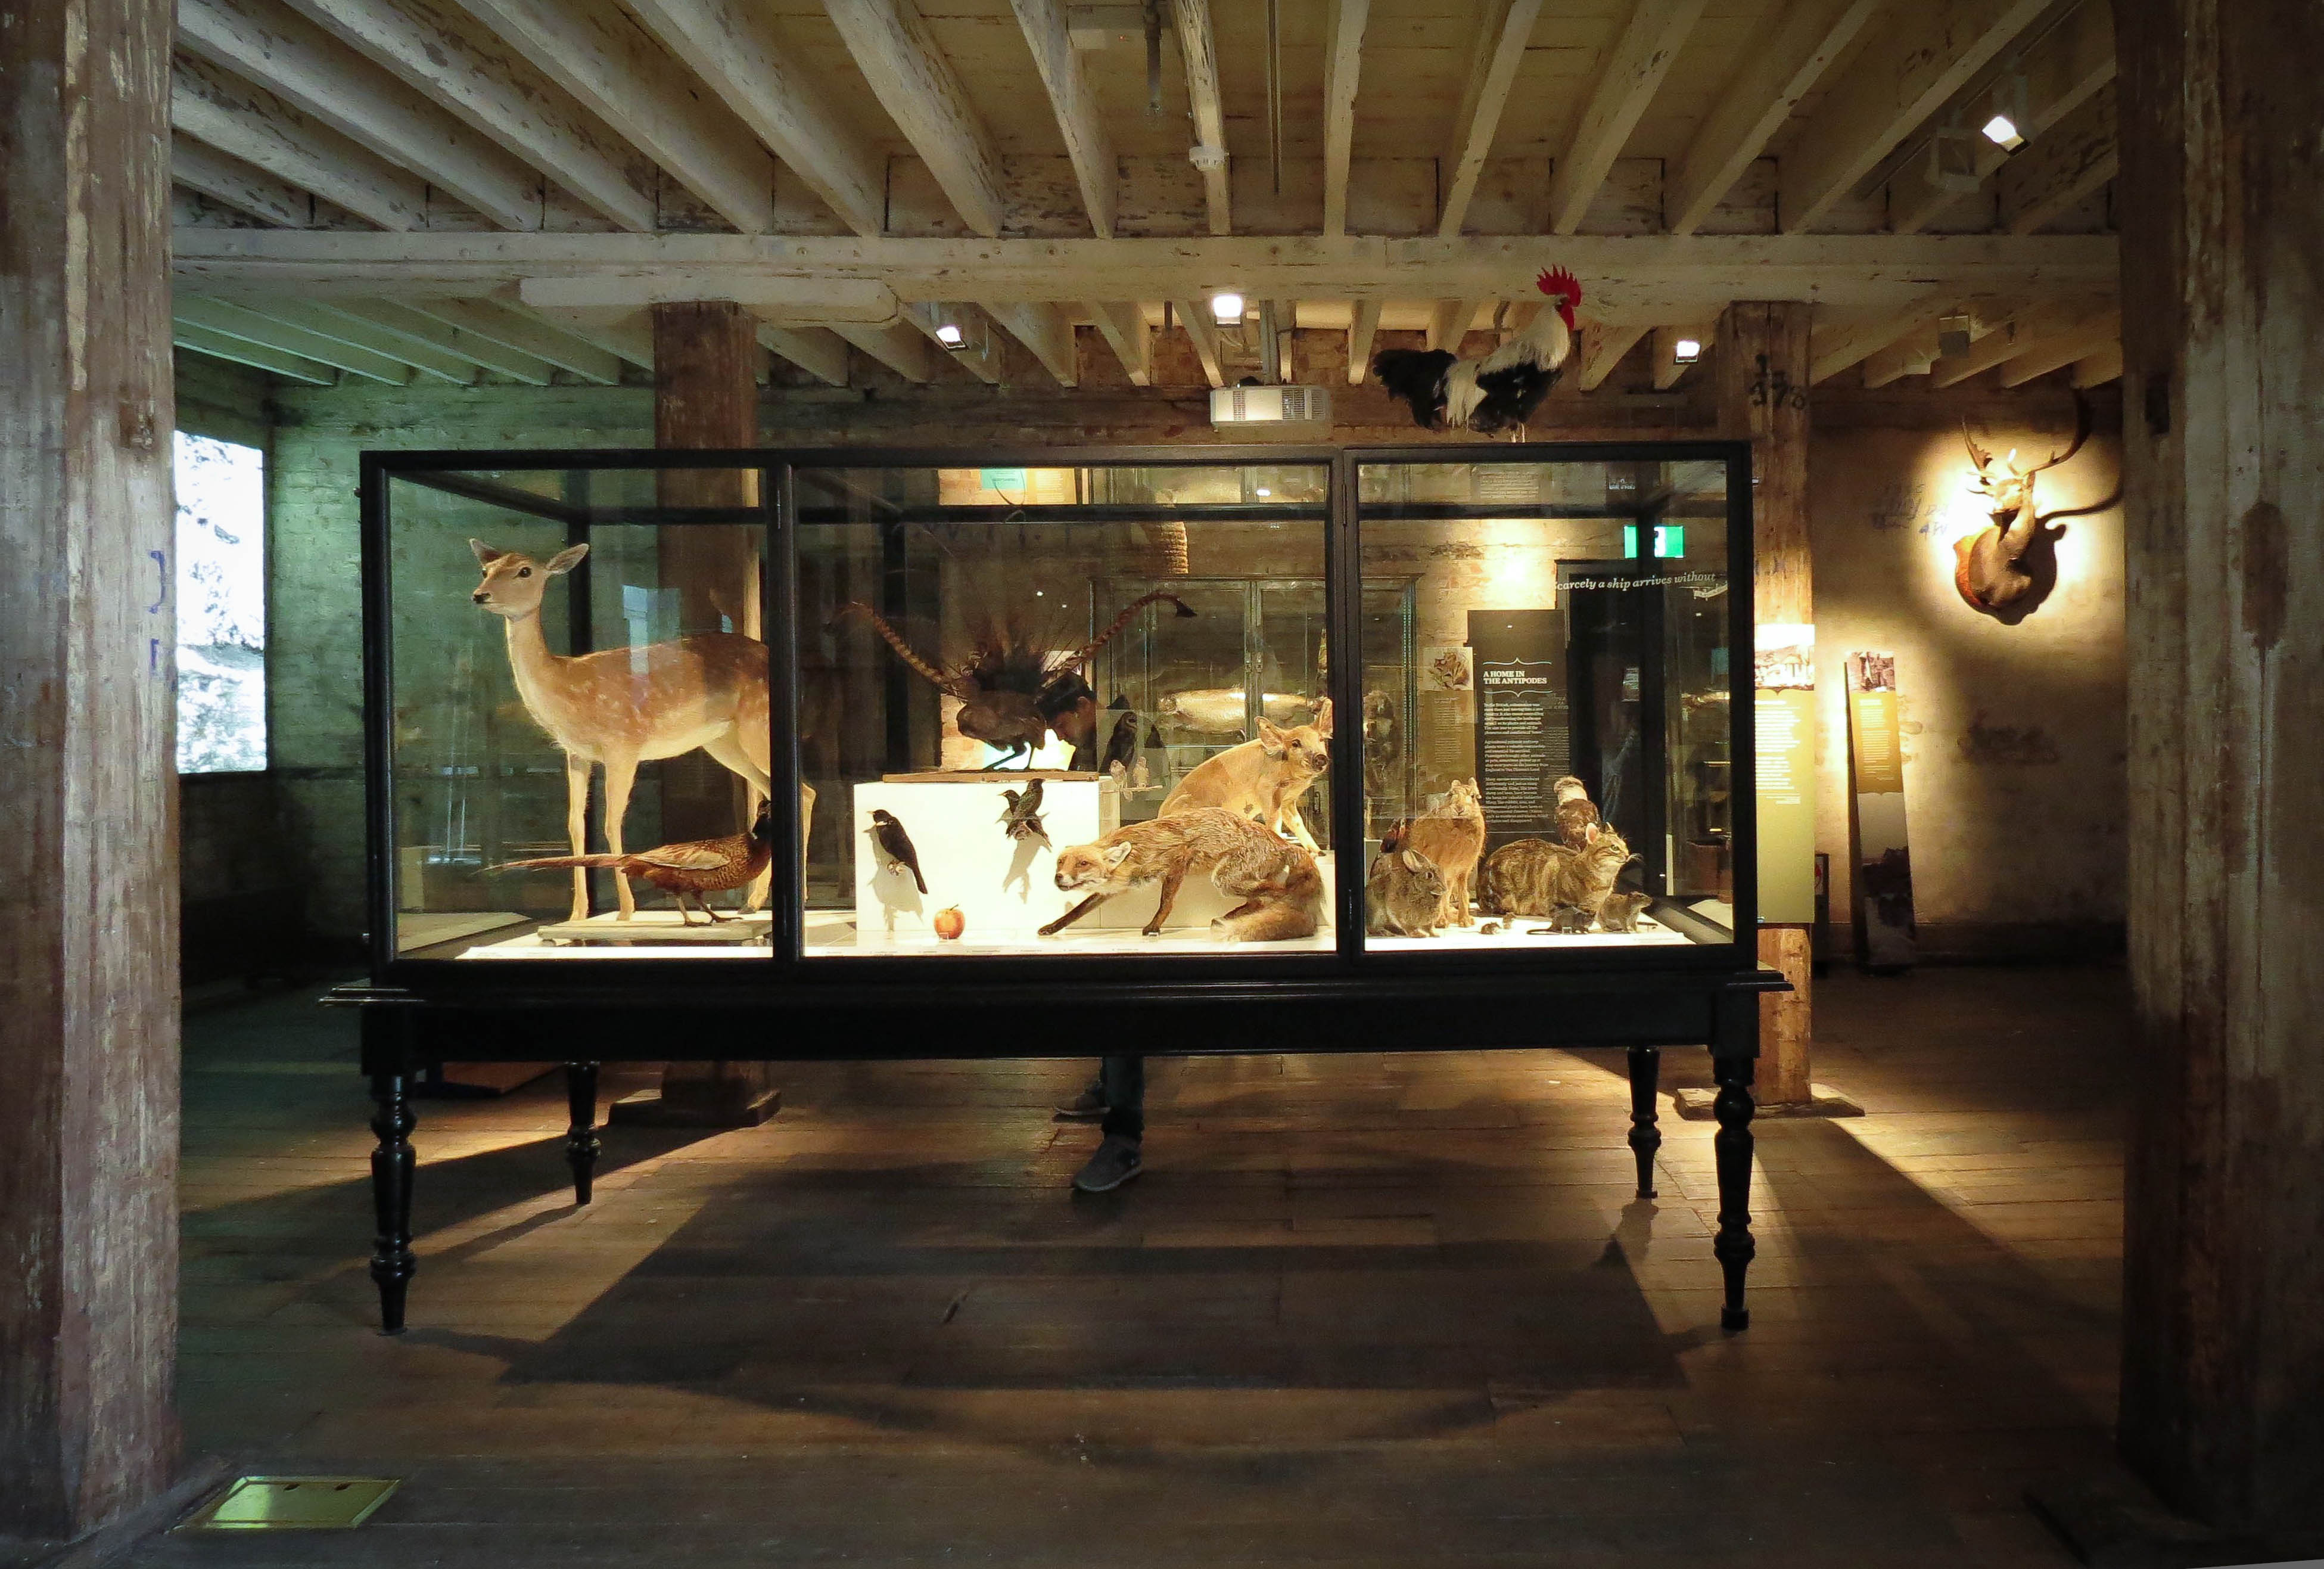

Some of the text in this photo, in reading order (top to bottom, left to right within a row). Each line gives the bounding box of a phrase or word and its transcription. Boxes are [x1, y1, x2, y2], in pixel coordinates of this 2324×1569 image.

[1607, 577, 1631, 591] ship
[1632, 574, 1672, 588] arrives
[1674, 570, 1716, 583] without
